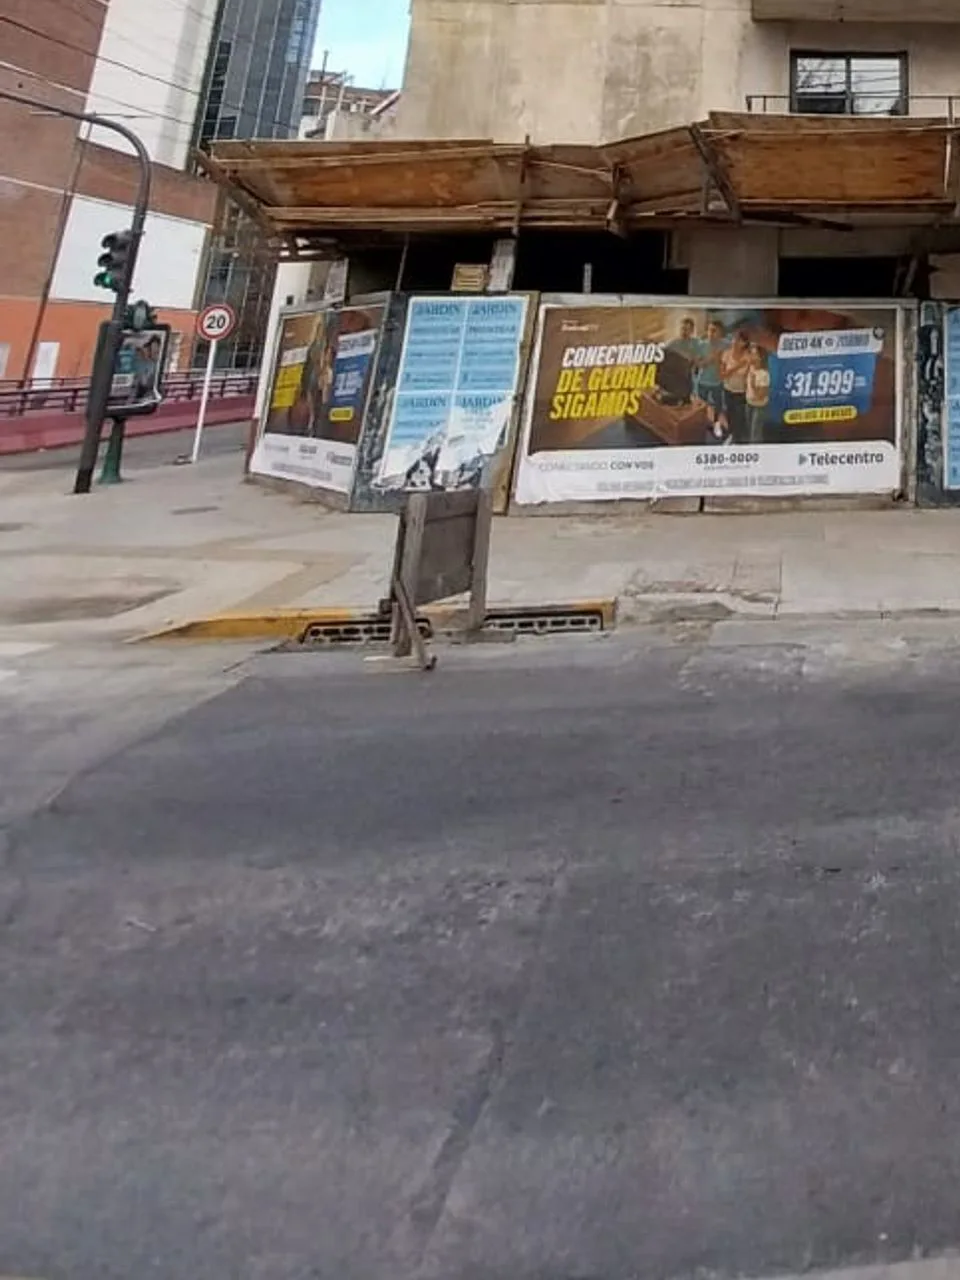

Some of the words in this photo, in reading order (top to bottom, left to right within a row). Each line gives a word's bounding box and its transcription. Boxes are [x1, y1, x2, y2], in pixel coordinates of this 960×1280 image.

[206, 315, 227, 330] 20
[562, 342, 665, 368] CONECTADOS
[556, 367, 586, 393] DE
[588, 363, 658, 392] GLORIA
[785, 368, 855, 397] $31.999
[550, 389, 642, 420] SIGAMOS
[695, 452, 760, 466] 6380-0000
[808, 452, 885, 467] Telecentro
